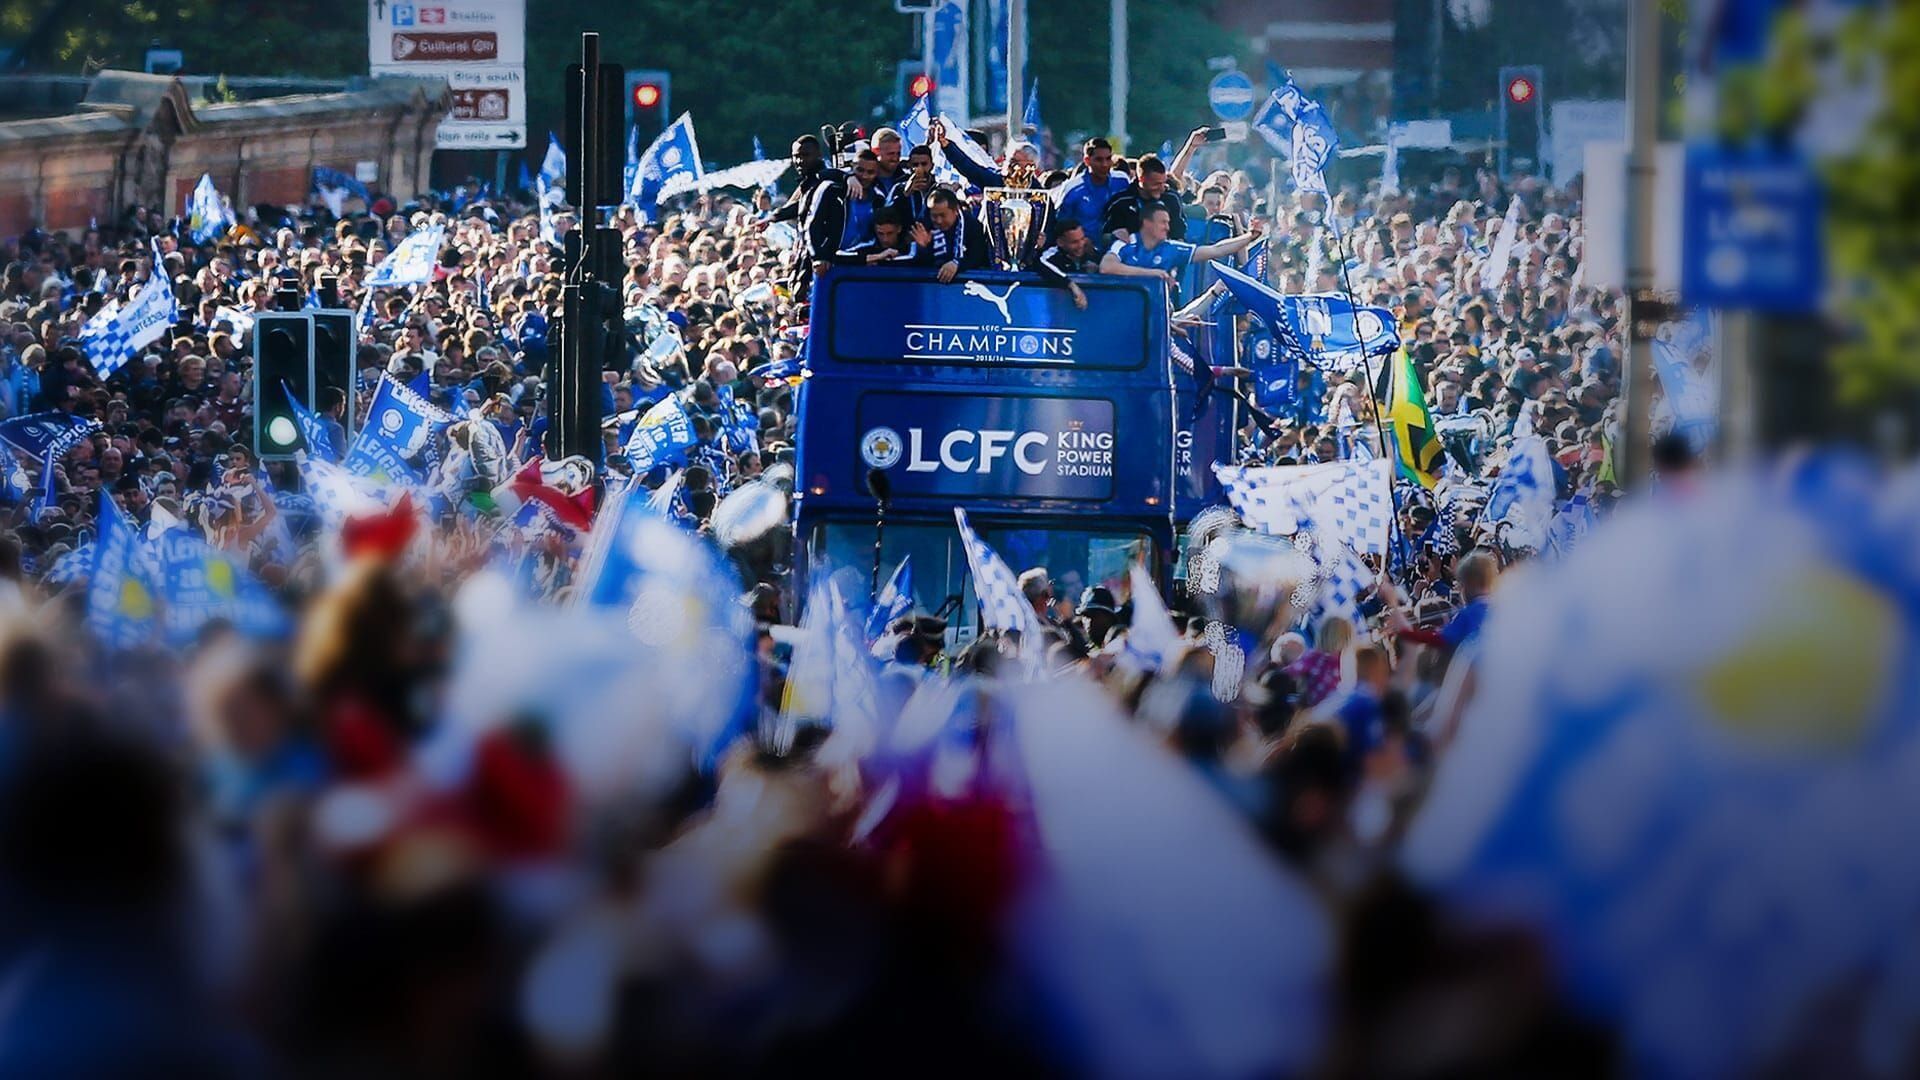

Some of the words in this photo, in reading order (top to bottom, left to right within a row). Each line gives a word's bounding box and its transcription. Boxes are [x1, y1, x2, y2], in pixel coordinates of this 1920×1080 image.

[906, 332, 1073, 356] CHAMPIONS
[1057, 431, 1113, 450] KING
[906, 428, 1049, 475] LCFC
[1057, 450, 1113, 465] POWER
[1057, 465, 1113, 478] STADIUM
